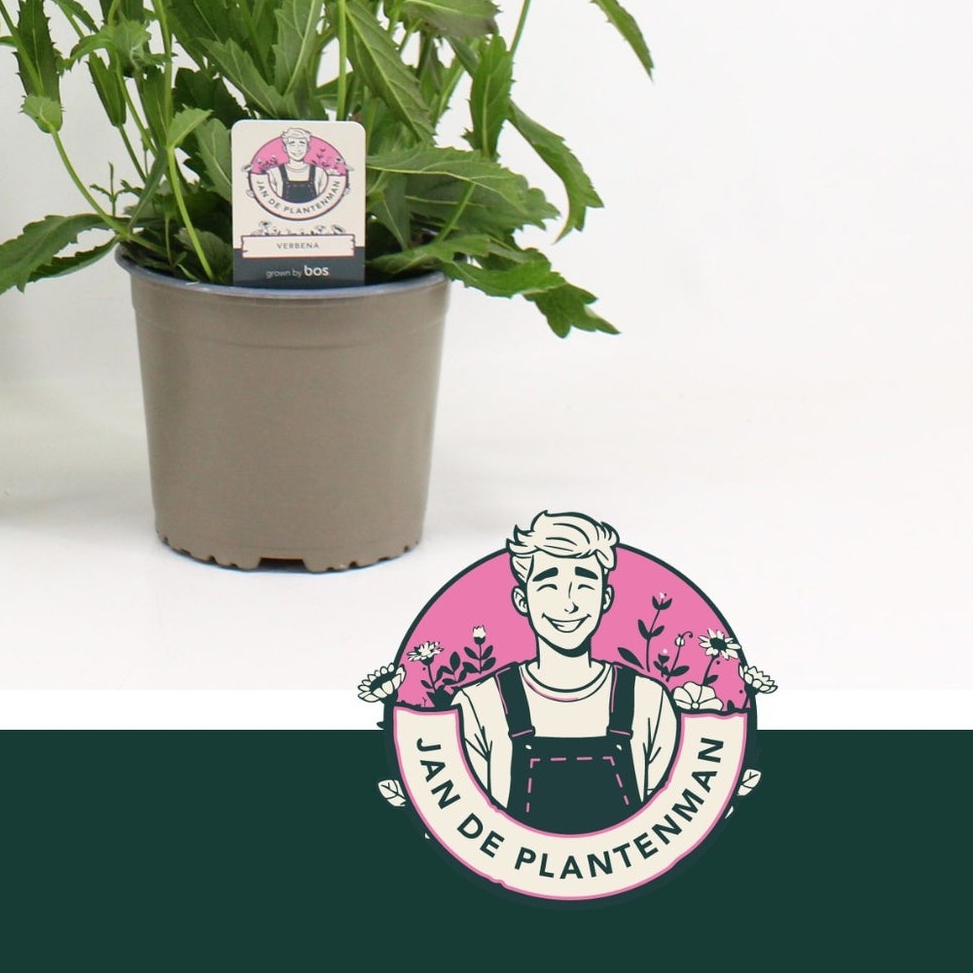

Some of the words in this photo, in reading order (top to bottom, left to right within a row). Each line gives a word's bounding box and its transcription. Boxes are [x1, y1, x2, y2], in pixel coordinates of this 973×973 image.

[257, 180, 269, 198] JAN
[269, 199, 281, 210] DE
[283, 180, 341, 214] PLANTENMAN
[276, 242, 320, 250] VERBENA
[266, 269, 291, 278] grown
[292, 268, 303, 278] by
[303, 264, 329, 277] bos
